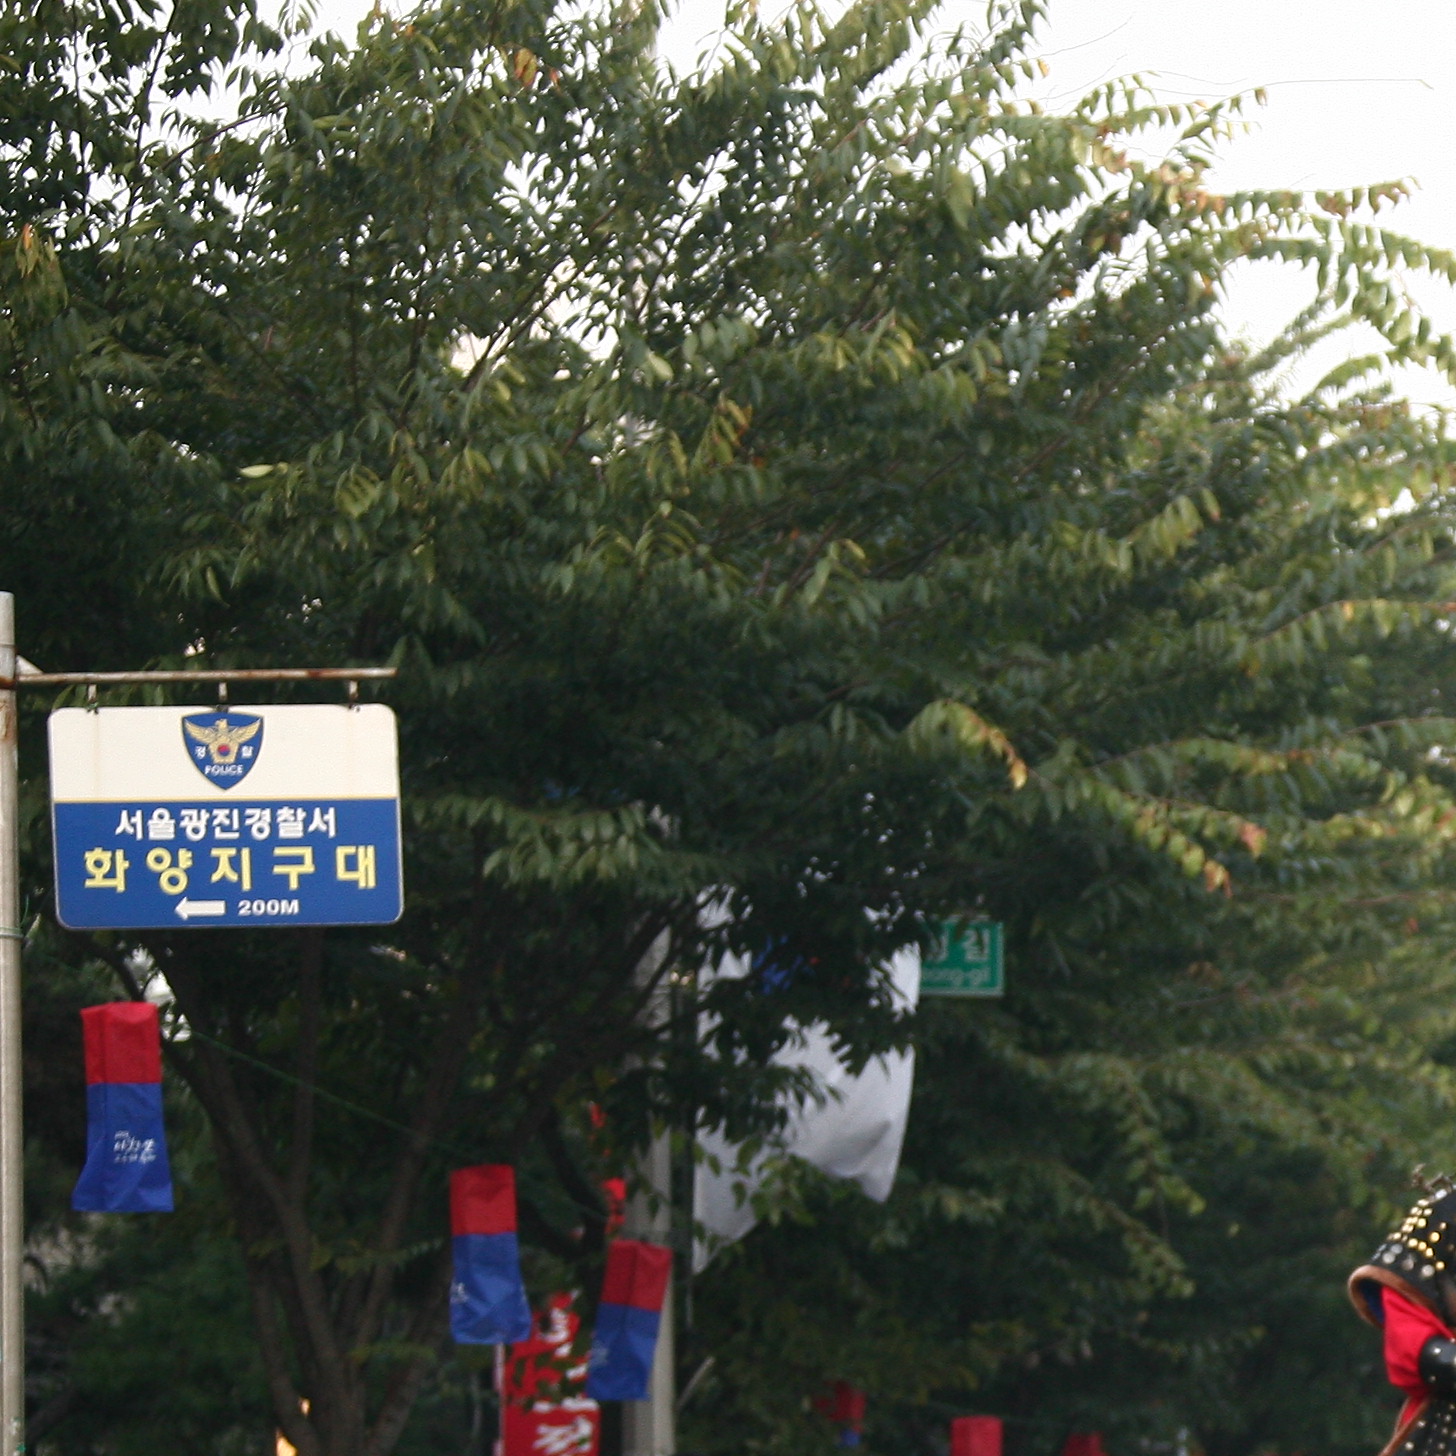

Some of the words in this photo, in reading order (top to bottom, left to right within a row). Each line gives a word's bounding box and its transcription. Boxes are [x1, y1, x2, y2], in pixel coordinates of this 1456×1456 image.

[205, 764, 244, 776] POLICE
[115, 806, 337, 841] 서울광진경찰서
[83, 844, 378, 895] 화양지구대
[237, 898, 300, 916] 200M
